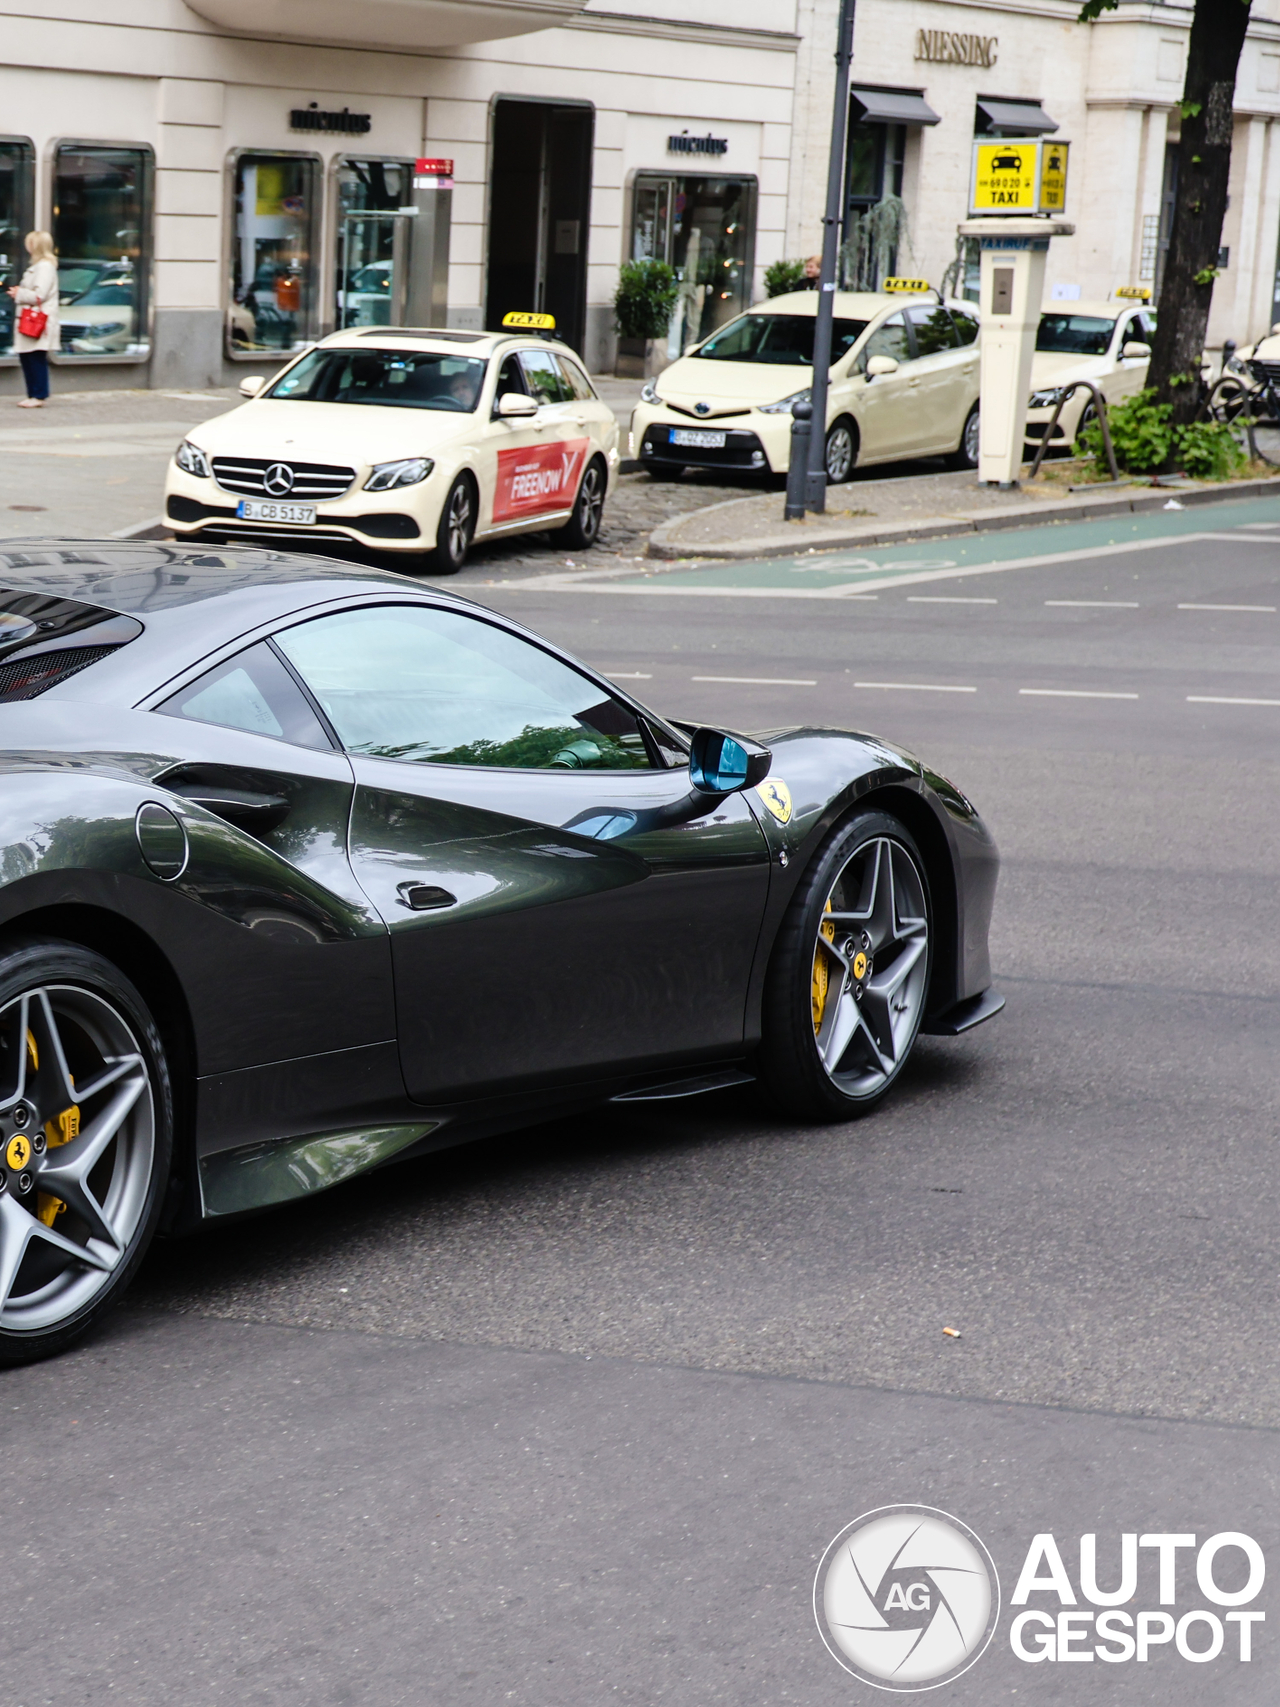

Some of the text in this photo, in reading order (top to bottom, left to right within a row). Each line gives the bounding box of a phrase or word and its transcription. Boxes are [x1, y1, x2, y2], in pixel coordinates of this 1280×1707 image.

[914, 29, 998, 68] NIESSING
[290, 101, 371, 133] mientus
[667, 129, 728, 154] mientus
[991, 191, 1020, 204] TAXI
[244, 503, 313, 521] B CB 5137
